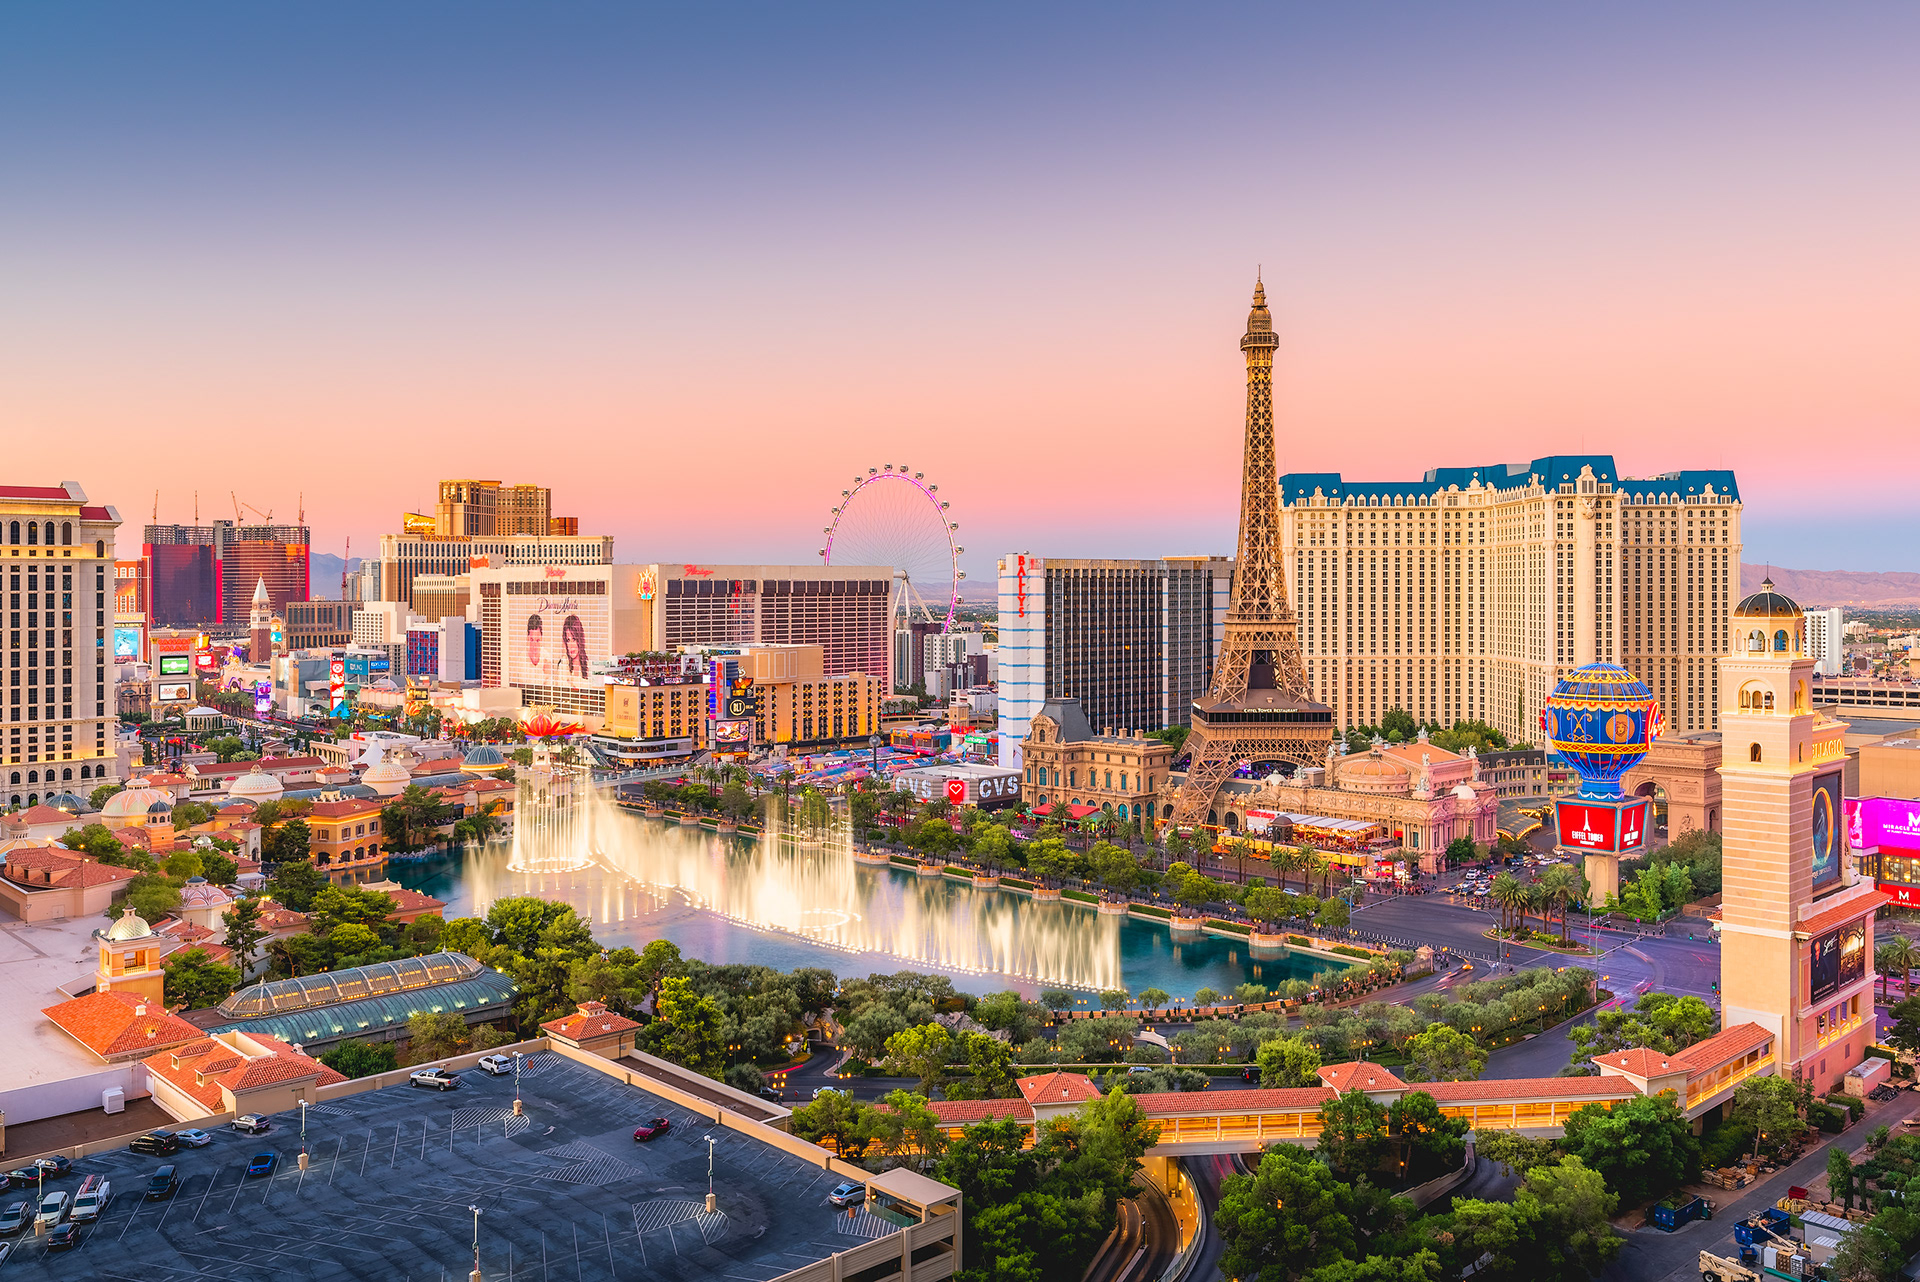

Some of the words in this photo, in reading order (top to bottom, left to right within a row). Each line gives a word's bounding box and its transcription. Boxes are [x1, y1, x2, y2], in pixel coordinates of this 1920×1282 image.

[407, 518, 435, 527] Encore
[733, 703, 742, 712] BLT
[1812, 738, 1842, 758] ELLAGIO
[895, 776, 932, 798] CVS
[979, 776, 1019, 798] CVS
[1571, 830, 1587, 840] EIFFEL
[1587, 832, 1604, 842] TOWER
[1899, 890, 1910, 901] M
